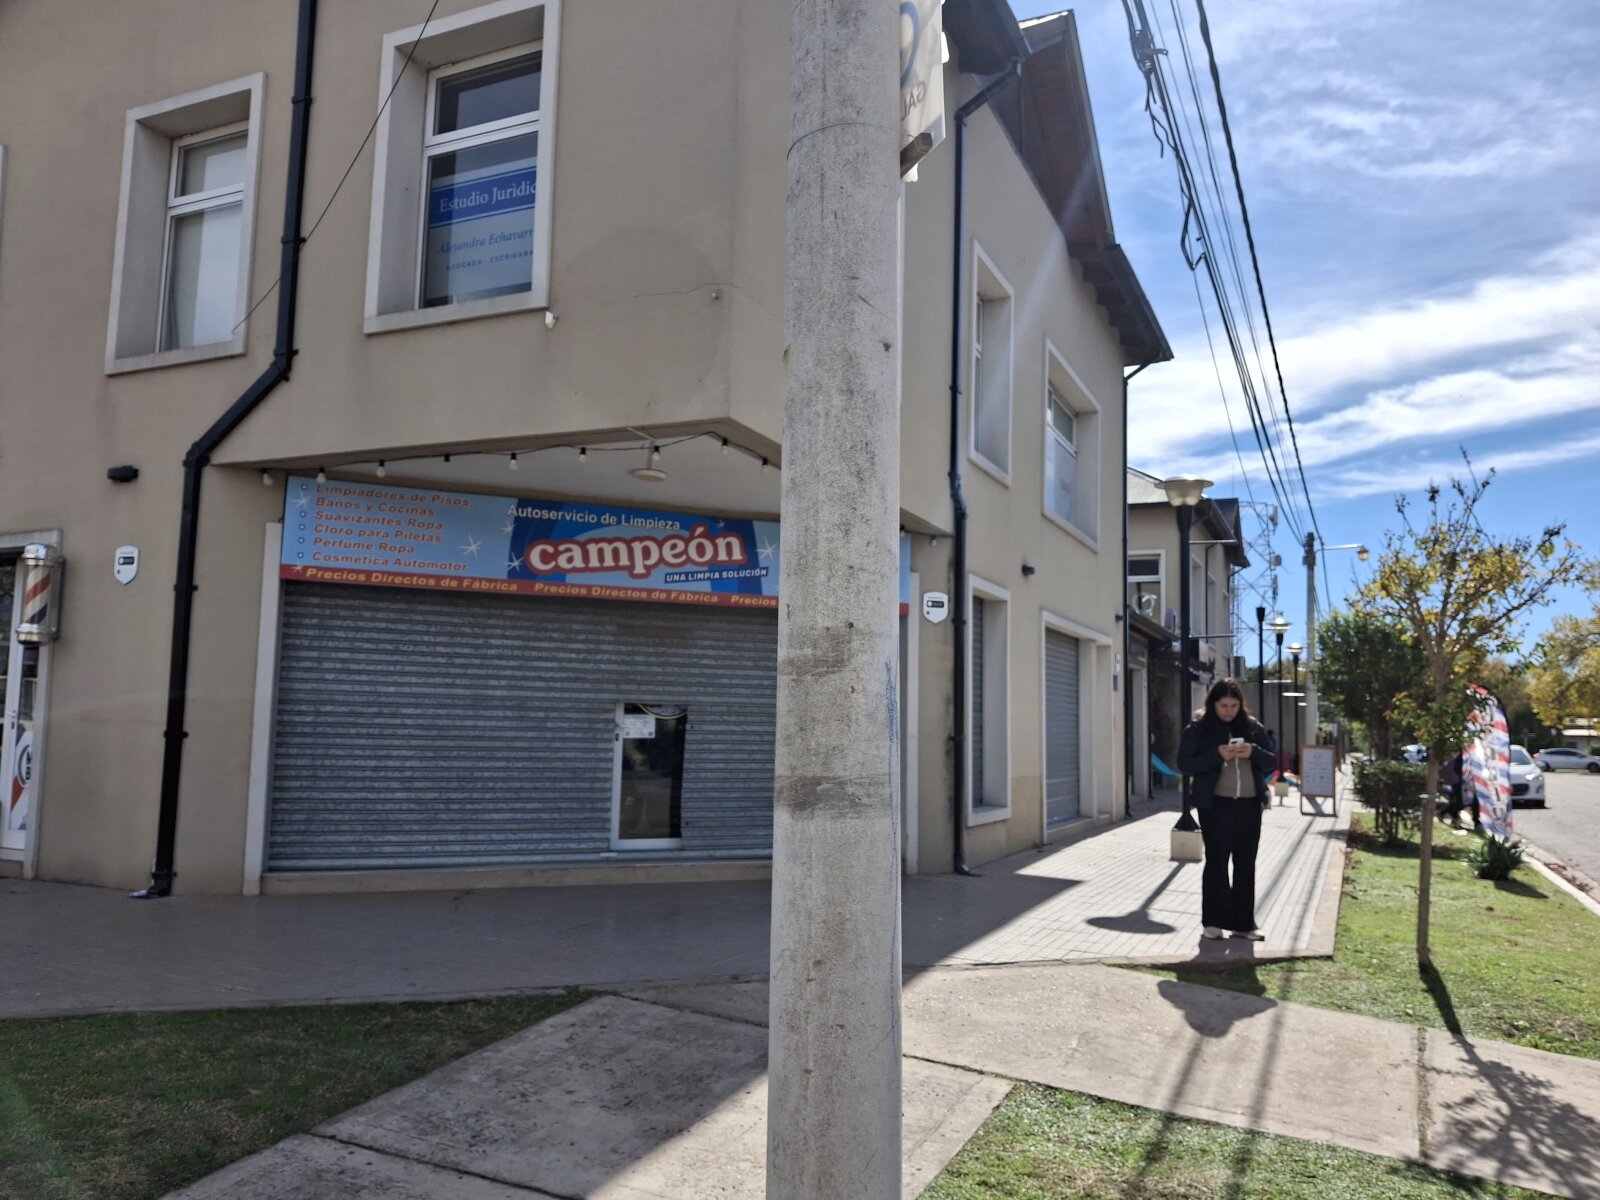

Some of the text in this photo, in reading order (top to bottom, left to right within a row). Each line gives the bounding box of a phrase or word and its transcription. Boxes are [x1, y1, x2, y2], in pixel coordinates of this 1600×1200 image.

[439, 180, 537, 213] Estudio Juridic
[488, 228, 534, 246] Echavarr
[317, 483, 405, 501] Limpiadores
[410, 493, 427, 503] de
[366, 503, 374, 513] y
[378, 502, 435, 517] Cocinas
[507, 504, 681, 531] Autoservicio de Limpieza
[315, 510, 443, 531] Suavizantes Ropa
[314, 523, 443, 543] Cloro para Piletas
[313, 537, 415, 554] Perfume Ropa
[528, 526, 744, 575] campeón
[393, 558, 468, 571] Automotor
[666, 567, 768, 582] UNA LIMPIA SOLUCIÓN
[306, 567, 777, 607] Precios Directos de Fábrica Precios Directos de Fábrica Precios
